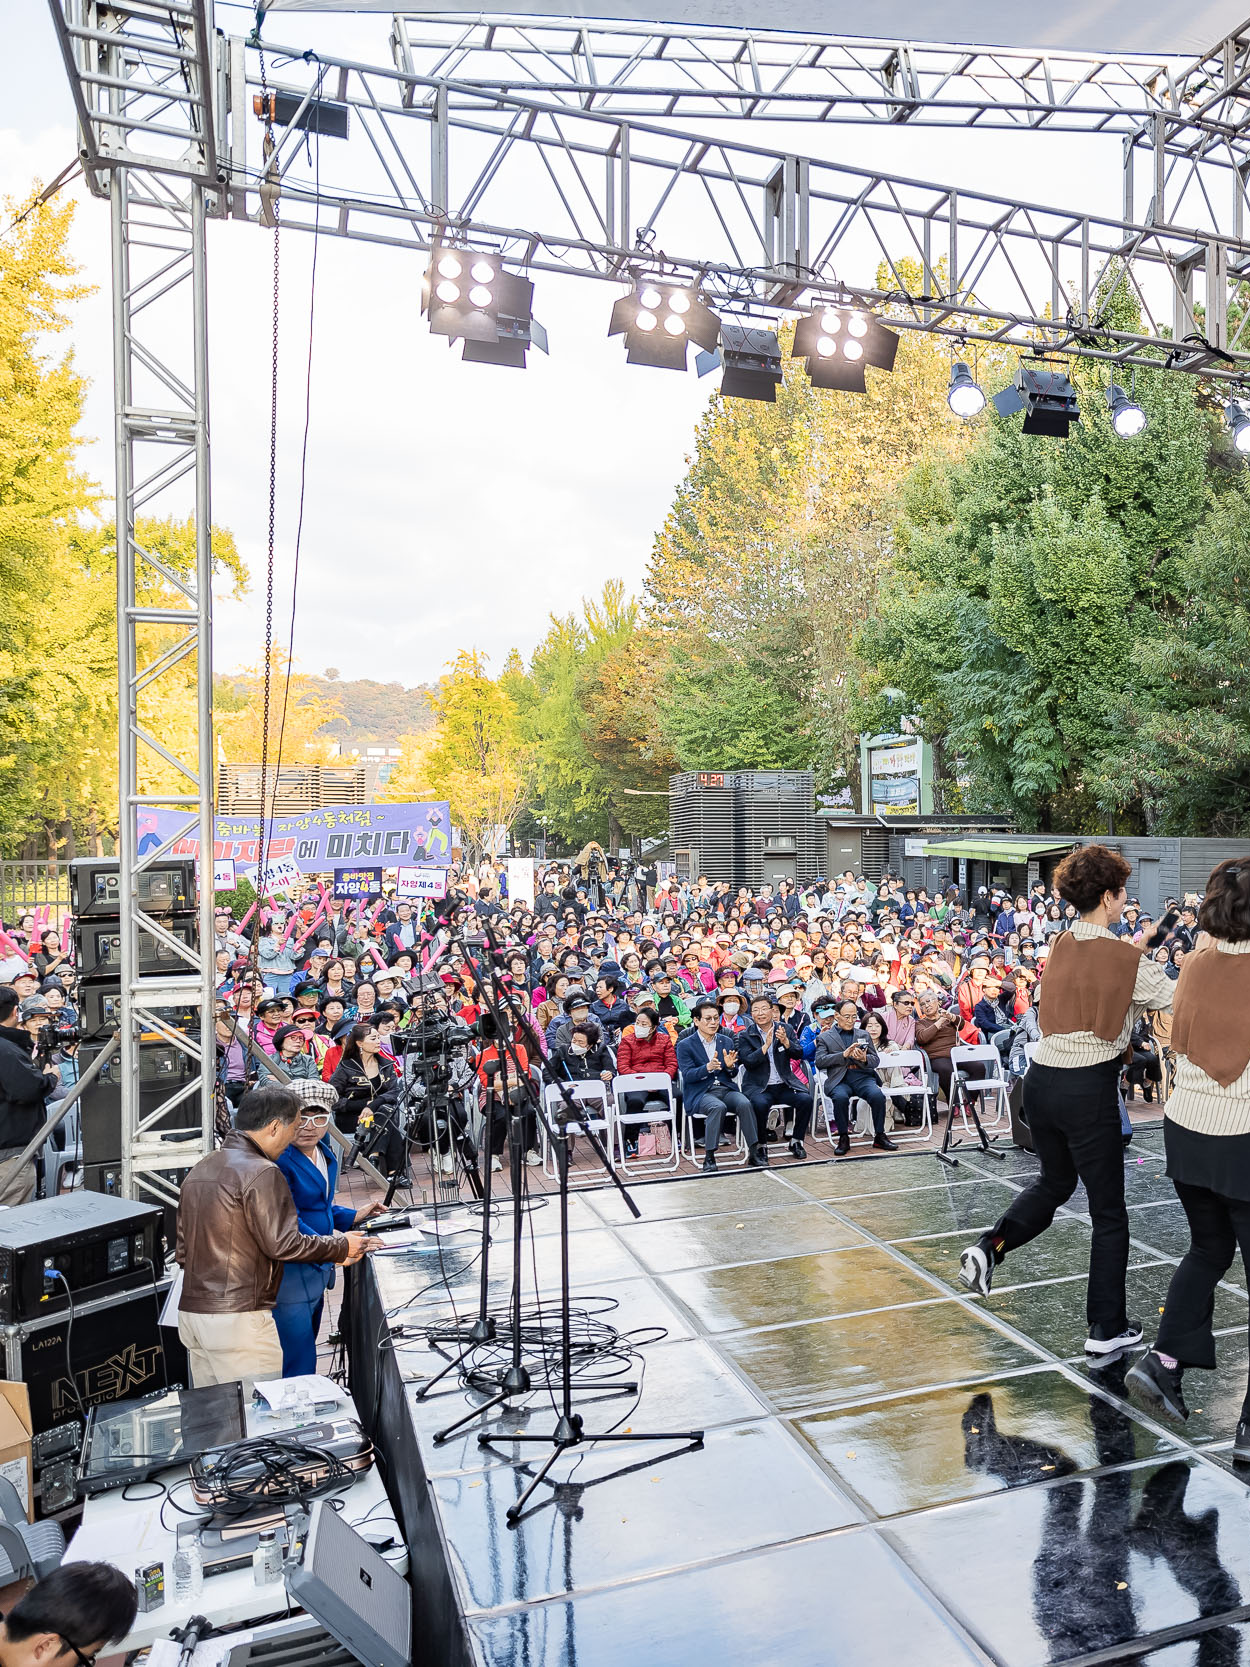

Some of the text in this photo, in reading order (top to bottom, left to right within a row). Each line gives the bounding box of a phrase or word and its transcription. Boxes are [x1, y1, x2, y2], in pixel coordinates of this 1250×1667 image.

[277, 809, 371, 833] 자양4동처럼
[326, 831, 410, 859] 미치다
[336, 880, 381, 895] 자양4동
[400, 879, 442, 890] 자양제4동
[32, 1336, 62, 1352] LA122A
[51, 1343, 164, 1409] NEXT
